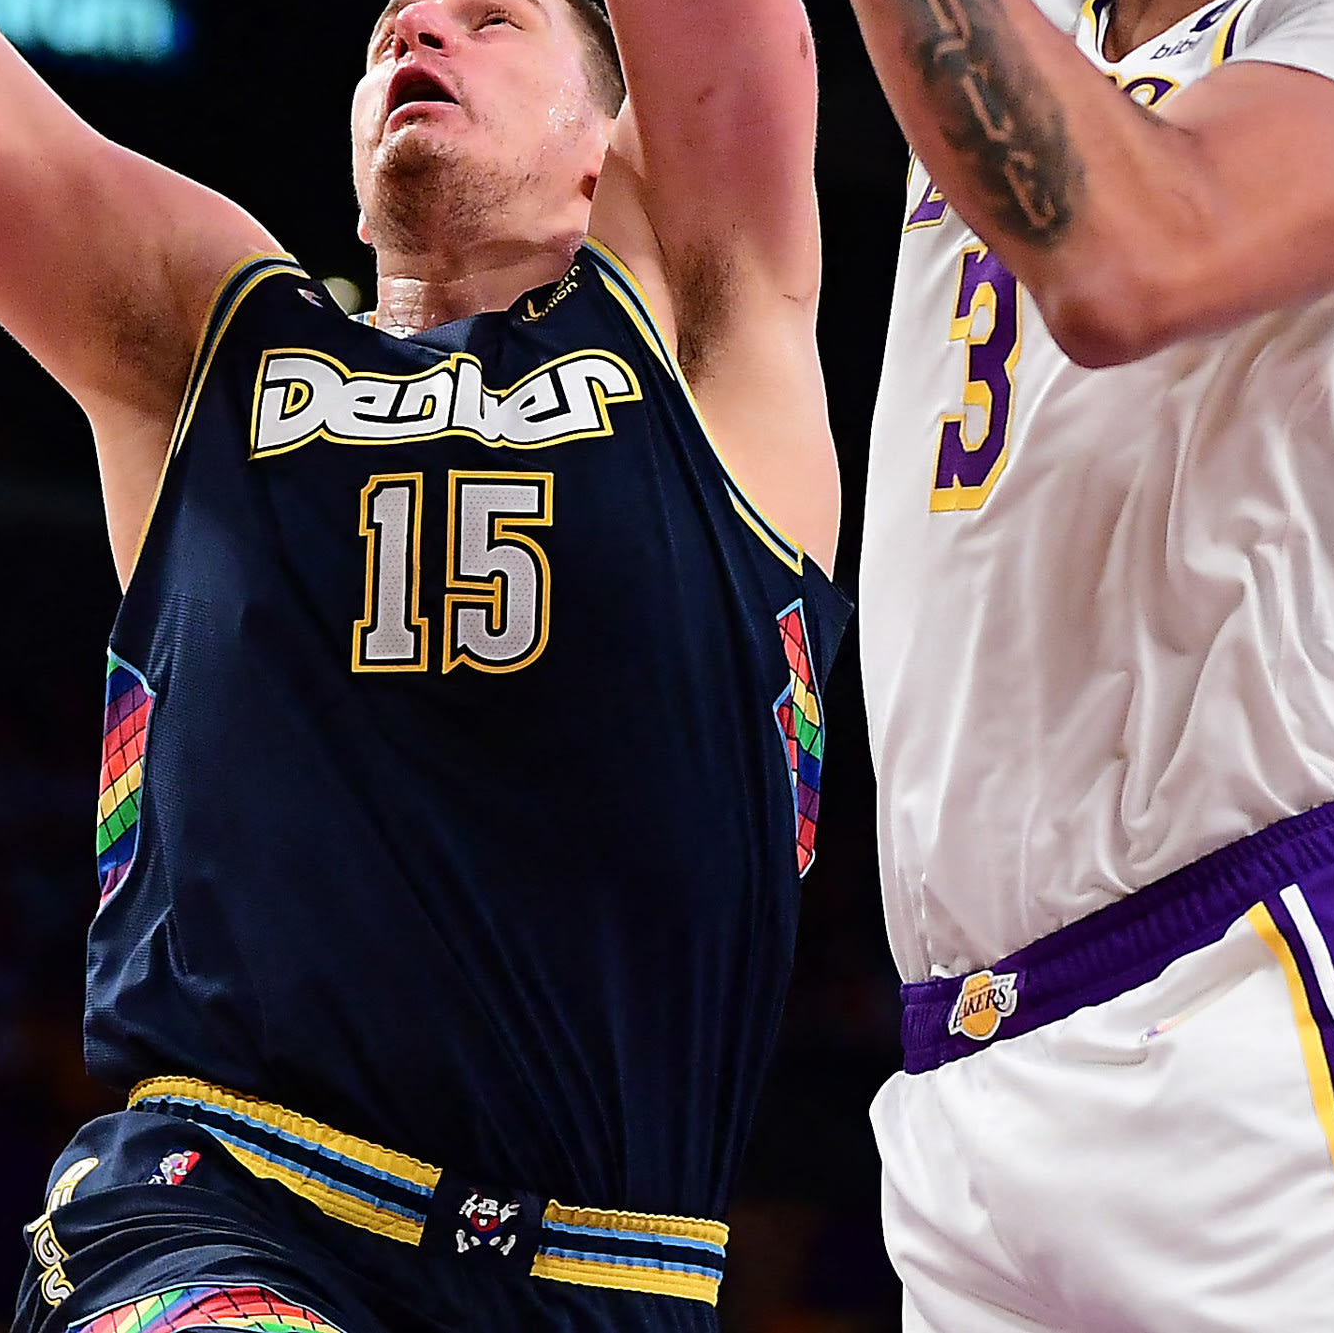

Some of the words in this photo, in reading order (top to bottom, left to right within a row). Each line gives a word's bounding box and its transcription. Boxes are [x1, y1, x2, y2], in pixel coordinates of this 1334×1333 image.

[250, 348, 644, 459] Denver
[929, 242, 1023, 513] 3
[351, 469, 555, 674] 15
